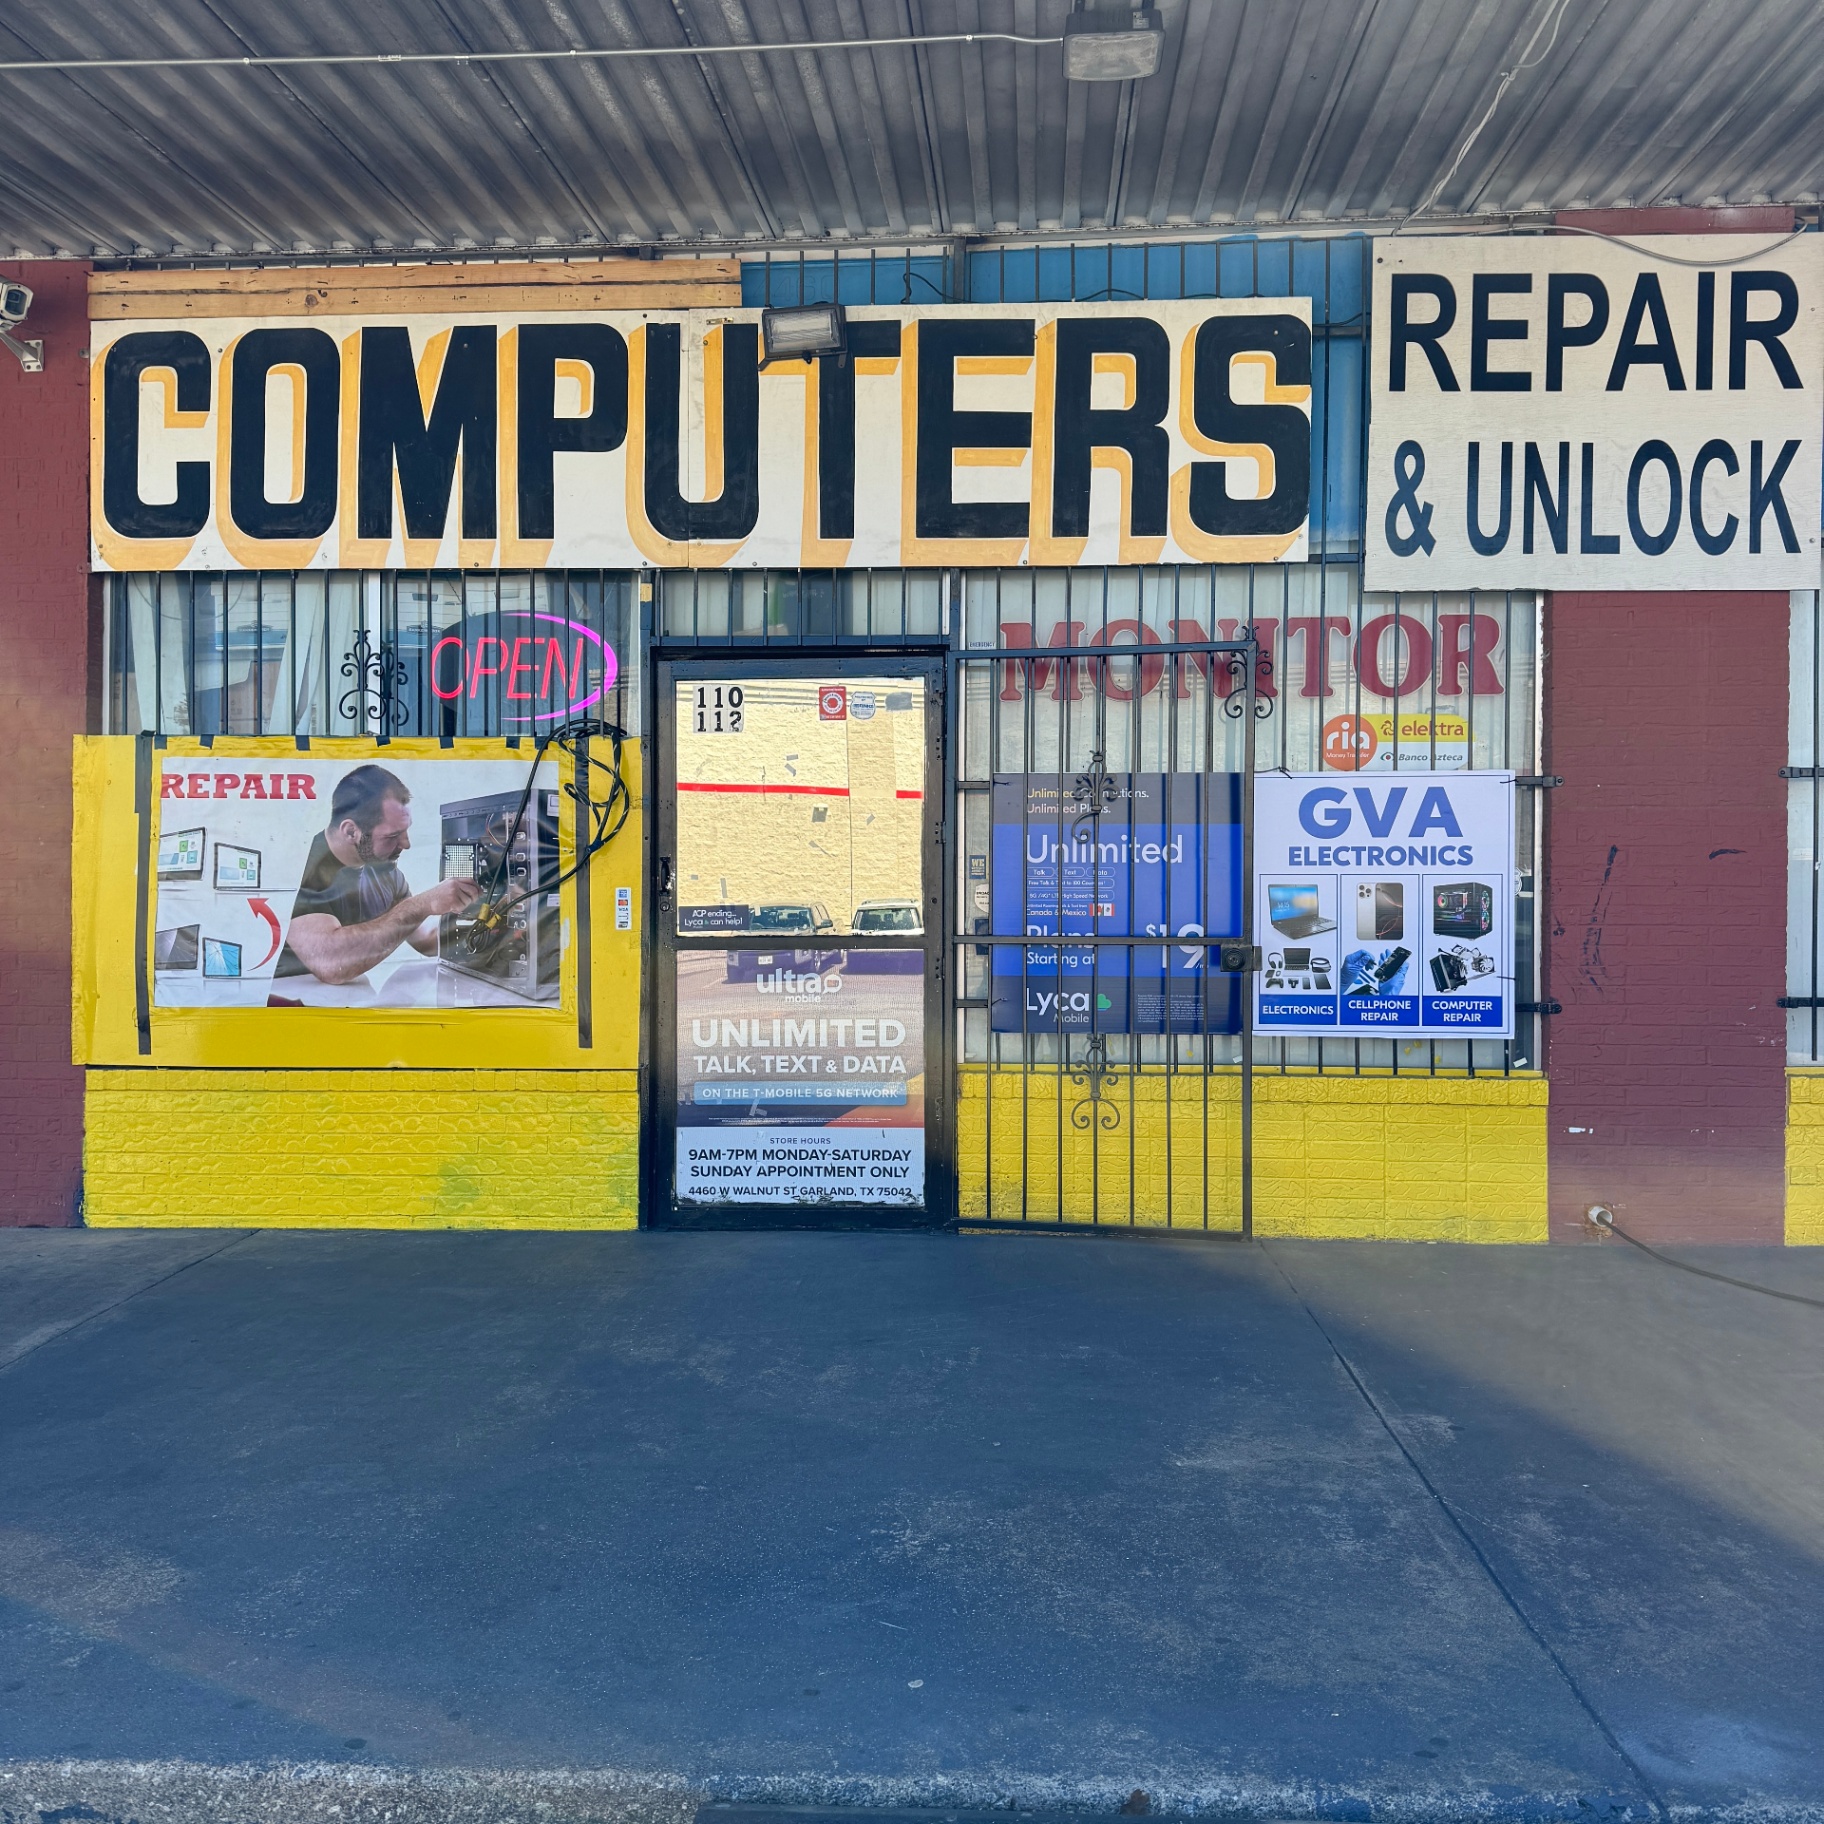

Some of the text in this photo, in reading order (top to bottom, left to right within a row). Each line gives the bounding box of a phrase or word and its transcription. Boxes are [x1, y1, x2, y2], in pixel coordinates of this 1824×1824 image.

[1389, 270, 1804, 392] REPAIR
[93, 314, 1312, 560] COMPUTERS
[1385, 438, 1803, 557] & UNLOCK
[999, 613, 1506, 702] MONITOR
[431, 636, 584, 700] OPEN
[697, 686, 743, 708] 110
[697, 710, 742, 732] 112
[1326, 721, 1370, 750] ria
[1398, 753, 1428, 762] Banco
[161, 773, 317, 800] REPAIR
[1027, 787, 1075, 798] Unlimie
[1027, 803, 1111, 814] Unlimied Pls.
[1298, 786, 1464, 839] GVA
[1027, 834, 1183, 863] Unlimited
[1288, 845, 1474, 867] ELECTRONICS
[1061, 908, 1087, 916] Mexico
[684, 919, 704, 927] Lyca
[1027, 951, 1078, 968] Startng
[756, 967, 822, 994] ultra
[785, 994, 821, 1003] mobile
[1026, 987, 1090, 1016] Lyca
[1348, 999, 1411, 1010] CELLPHONE
[1431, 1000, 1493, 1011] COMPUTER
[1262, 1005, 1334, 1015] ELECTRONICS
[1360, 1011, 1399, 1022] REPAIR
[1443, 1012, 1482, 1022] REPAIR
[1053, 1013, 1090, 1023] Mobile
[691, 1019, 906, 1048] UNLIMITED
[694, 1055, 907, 1075] TALK, TEXT & DATA
[702, 1088, 898, 1098] ON THE T-MOBILE 5G NETWORK
[769, 1137, 831, 1145] STORE HOURS
[688, 1149, 912, 1162] 9AM-7PM MONDAY-SATURDAY
[690, 1166, 910, 1178] SUNDAY APPOINTMENT ONLY
[688, 1186, 912, 1197] 4460 W WALNUT ST GARLAND, TX 75042
